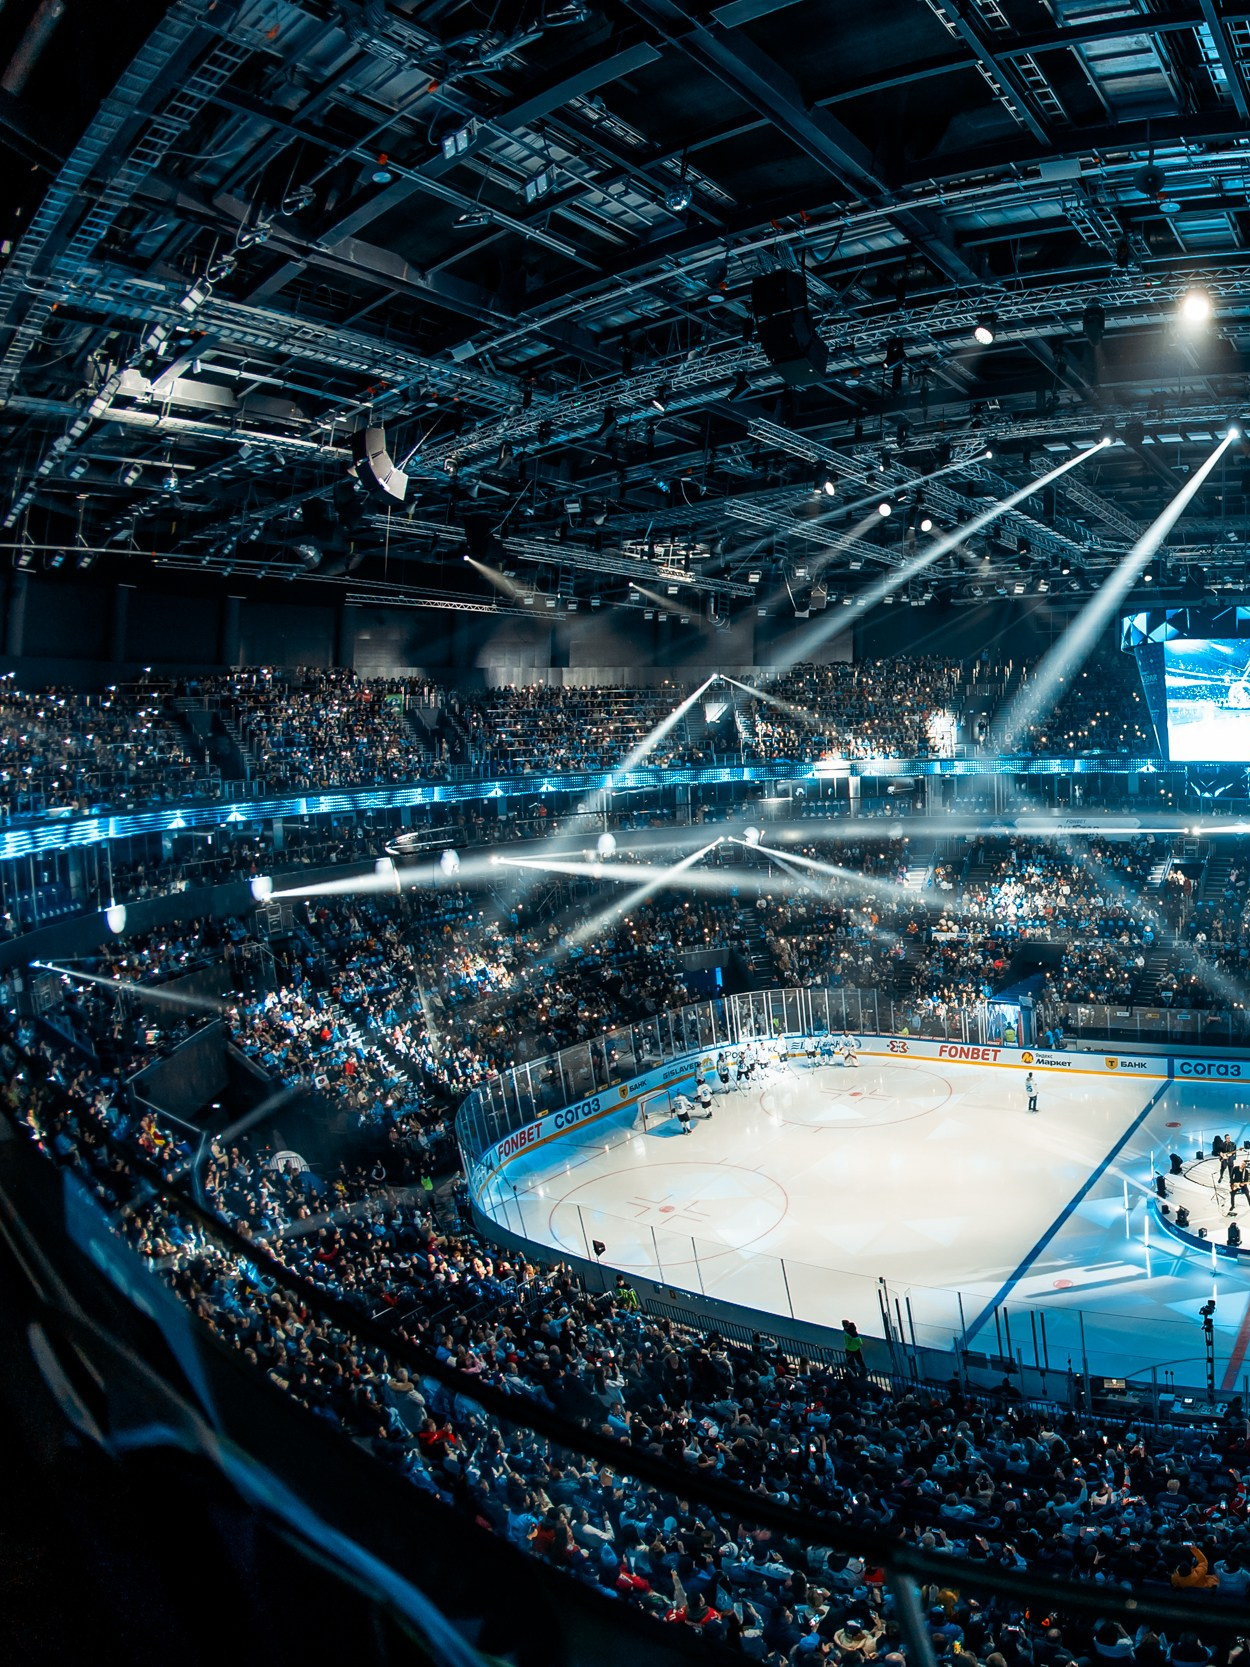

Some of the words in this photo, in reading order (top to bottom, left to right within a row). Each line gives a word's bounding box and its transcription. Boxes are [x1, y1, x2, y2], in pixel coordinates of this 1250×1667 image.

[939, 1045, 1001, 1061] FONBET
[1035, 1058, 1072, 1067] Маркет
[1120, 1061, 1147, 1069] БАНК
[662, 1061, 699, 1080] GISLAVED
[629, 1079, 647, 1092] БАНК
[498, 1122, 542, 1159] FONBET
